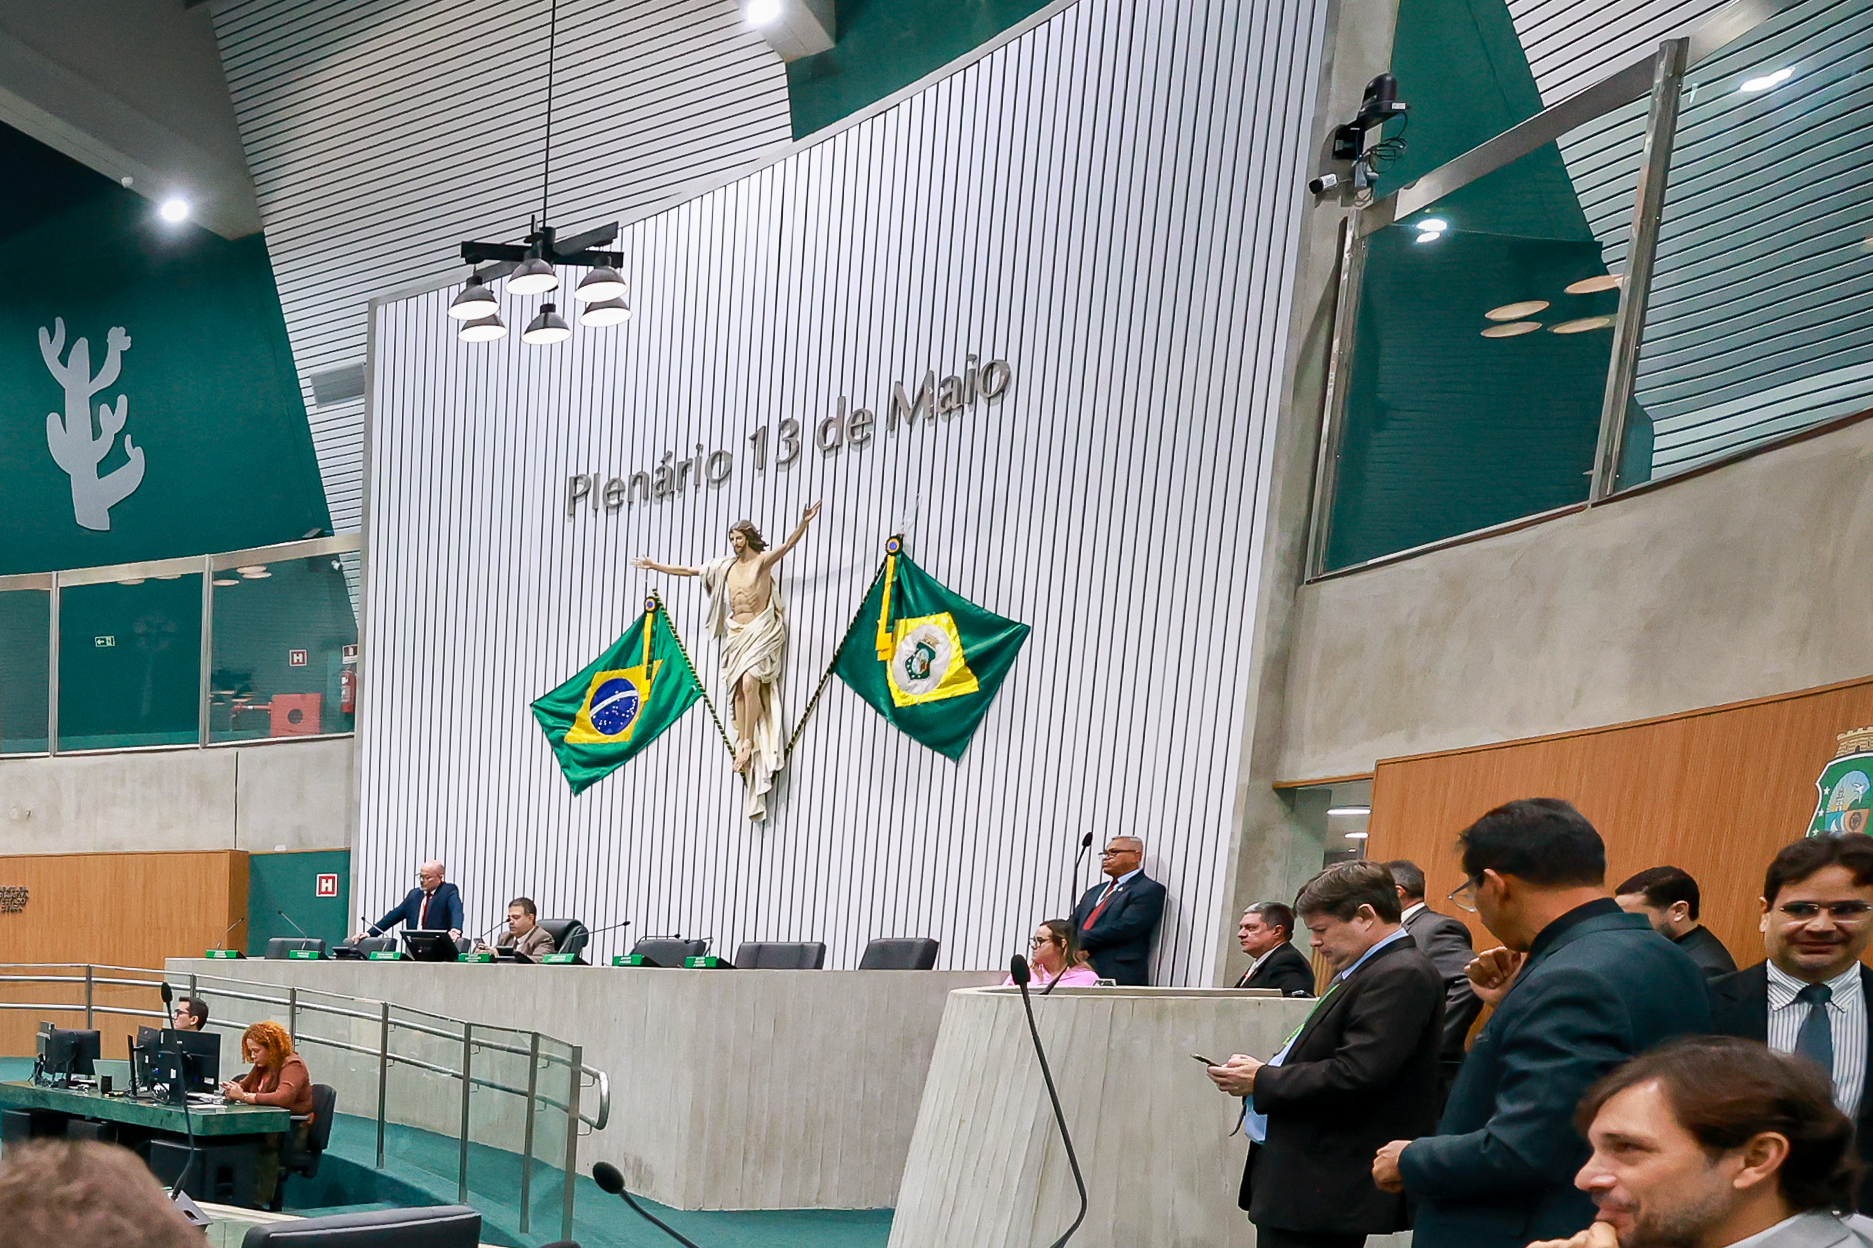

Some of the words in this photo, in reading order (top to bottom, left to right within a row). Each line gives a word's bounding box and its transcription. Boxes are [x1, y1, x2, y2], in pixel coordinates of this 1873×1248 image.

[567, 443, 733, 517] Plenário
[748, 418, 800, 470] 13
[817, 395, 874, 452] de
[886, 353, 1012, 435] Maio
[293, 653, 303, 663] H
[321, 878, 333, 892] H
